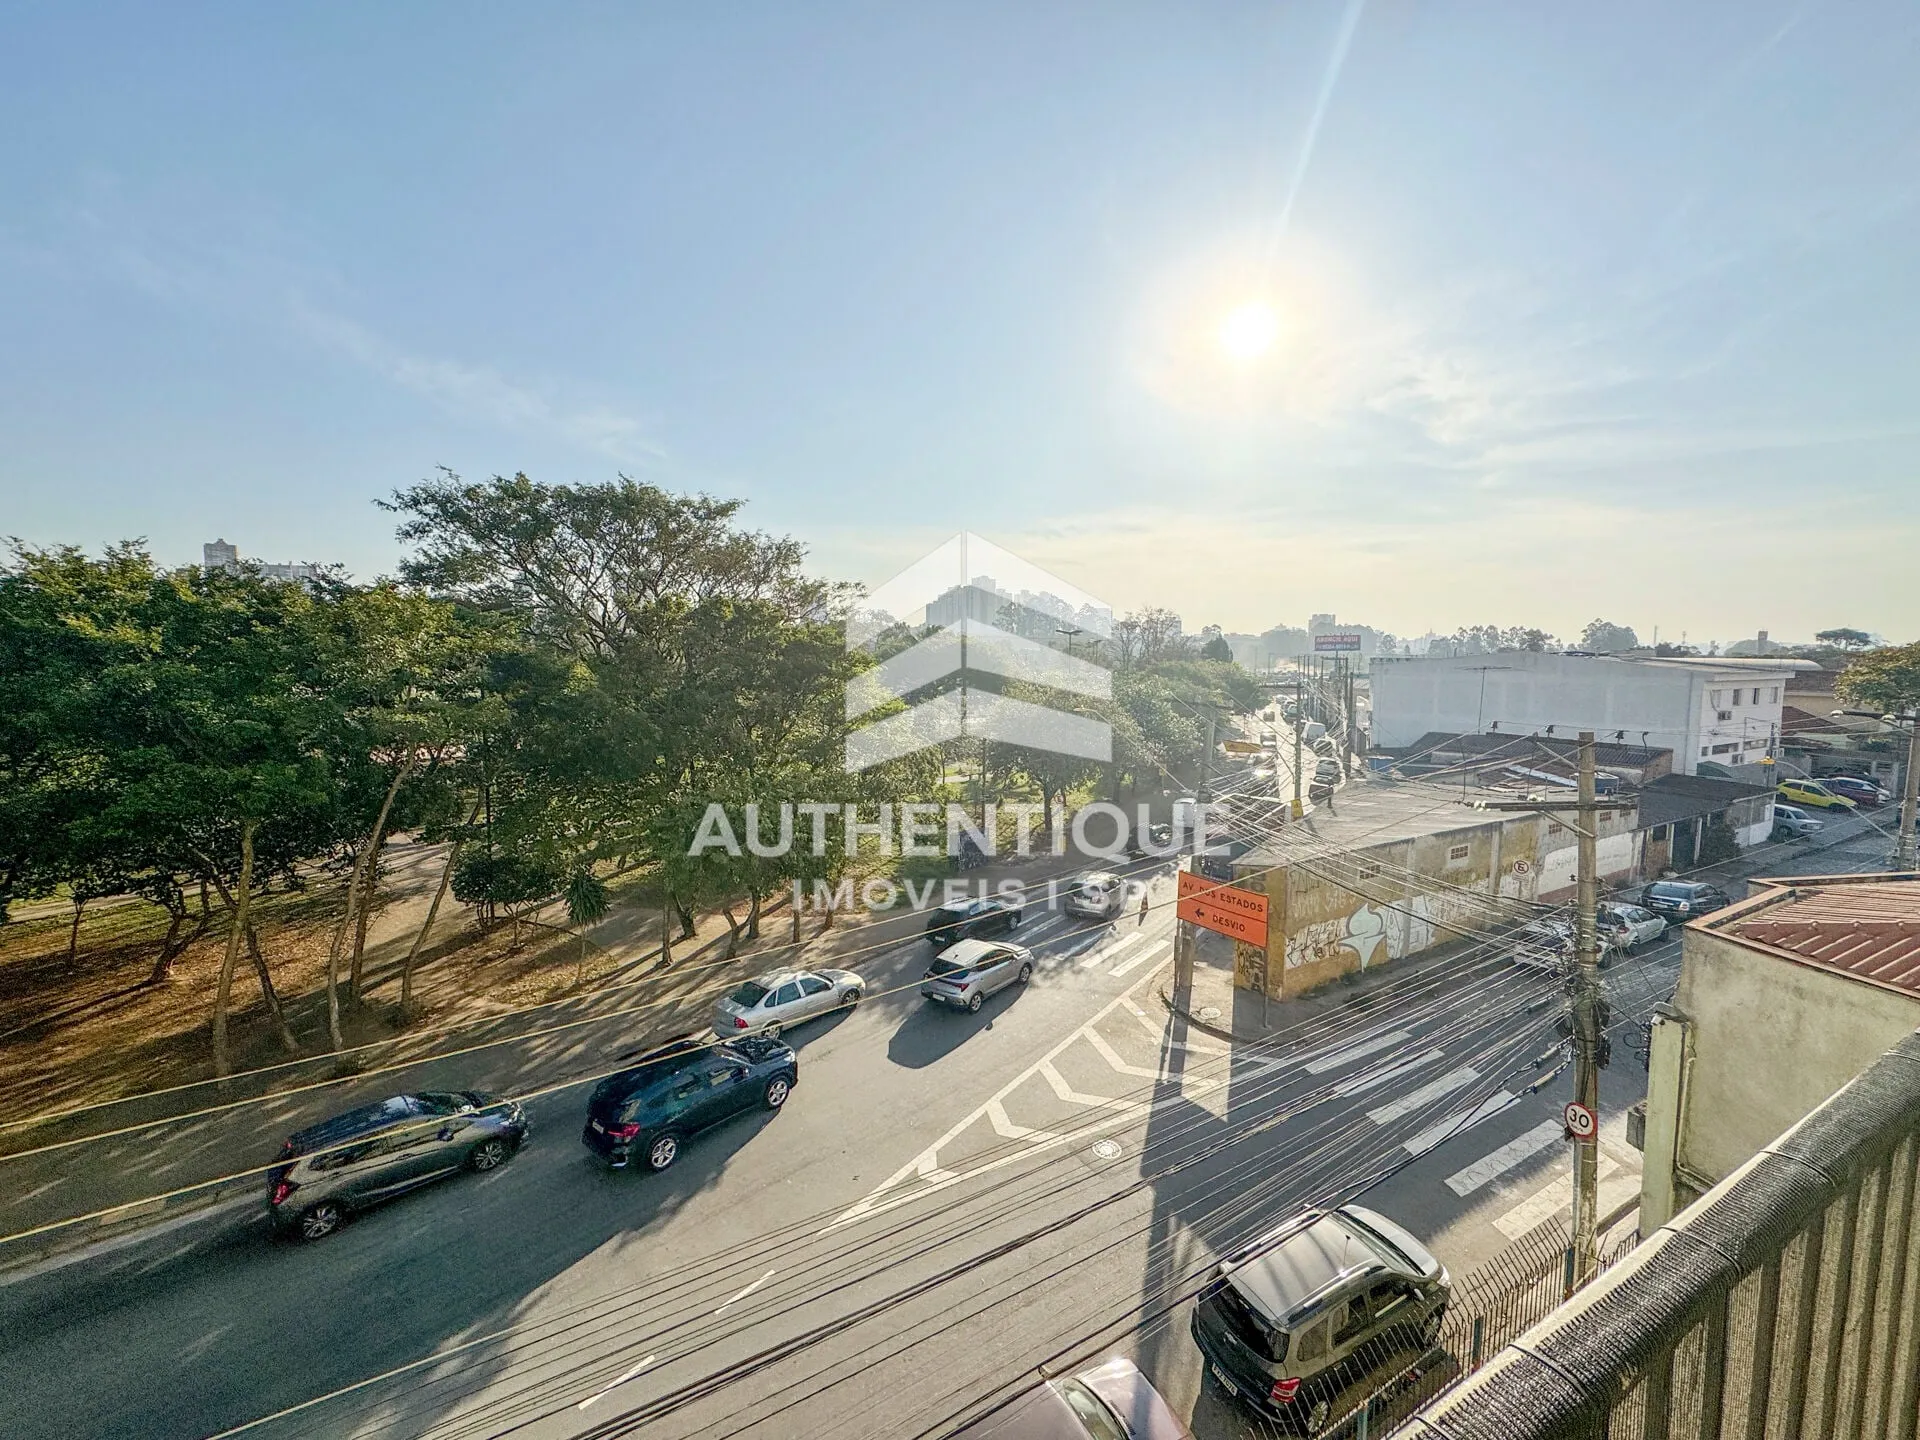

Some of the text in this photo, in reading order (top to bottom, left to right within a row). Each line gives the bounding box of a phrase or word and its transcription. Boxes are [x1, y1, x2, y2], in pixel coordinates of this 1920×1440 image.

[1220, 893, 1263, 913] ESTADOS
[1212, 914, 1246, 932] DESVIO
[1569, 1108, 1589, 1128] 30
